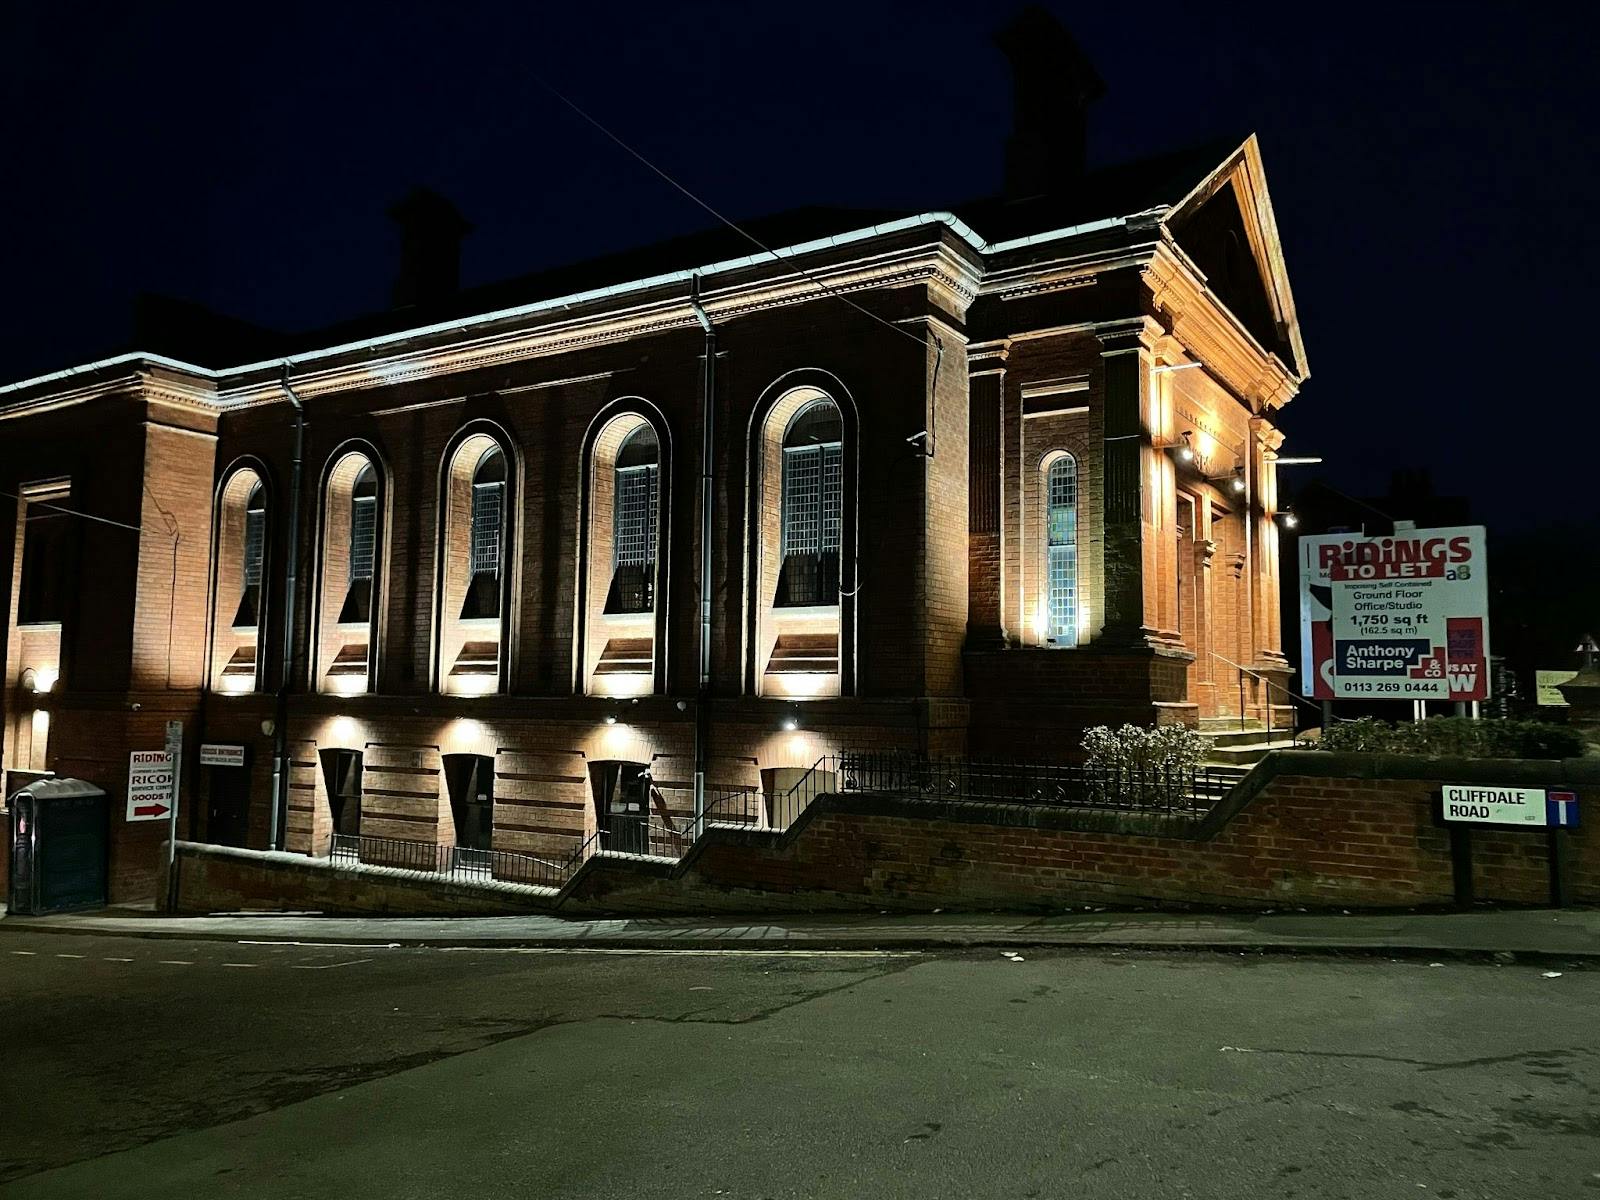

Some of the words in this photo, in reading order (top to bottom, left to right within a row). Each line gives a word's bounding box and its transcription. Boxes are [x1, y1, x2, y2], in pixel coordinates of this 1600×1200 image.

[1344, 565, 1376, 579] TO
[1385, 562, 1432, 577] LET
[1353, 591, 1392, 600] Ground
[1395, 590, 1423, 598] Floor
[1354, 601, 1423, 611] Office/Studio
[1350, 614, 1389, 627] 1,750
[1393, 616, 1412, 626] sq
[1416, 614, 1429, 624] ft
[1360, 626, 1388, 636] (162.5
[1391, 627, 1402, 635] sq
[1405, 626, 1418, 635] m)
[1346, 645, 1415, 658] Anthony
[1346, 657, 1404, 671] Sharpe
[1430, 659, 1440, 669] &
[1460, 664, 1478, 672] AT
[1344, 683, 1372, 692] 0113
[1377, 683, 1400, 692] 269
[1405, 683, 1439, 692] 0444
[131, 793, 164, 801] GOODS
[1449, 789, 1526, 805] CLIFFDALE
[1450, 805, 1490, 818] ROAD
